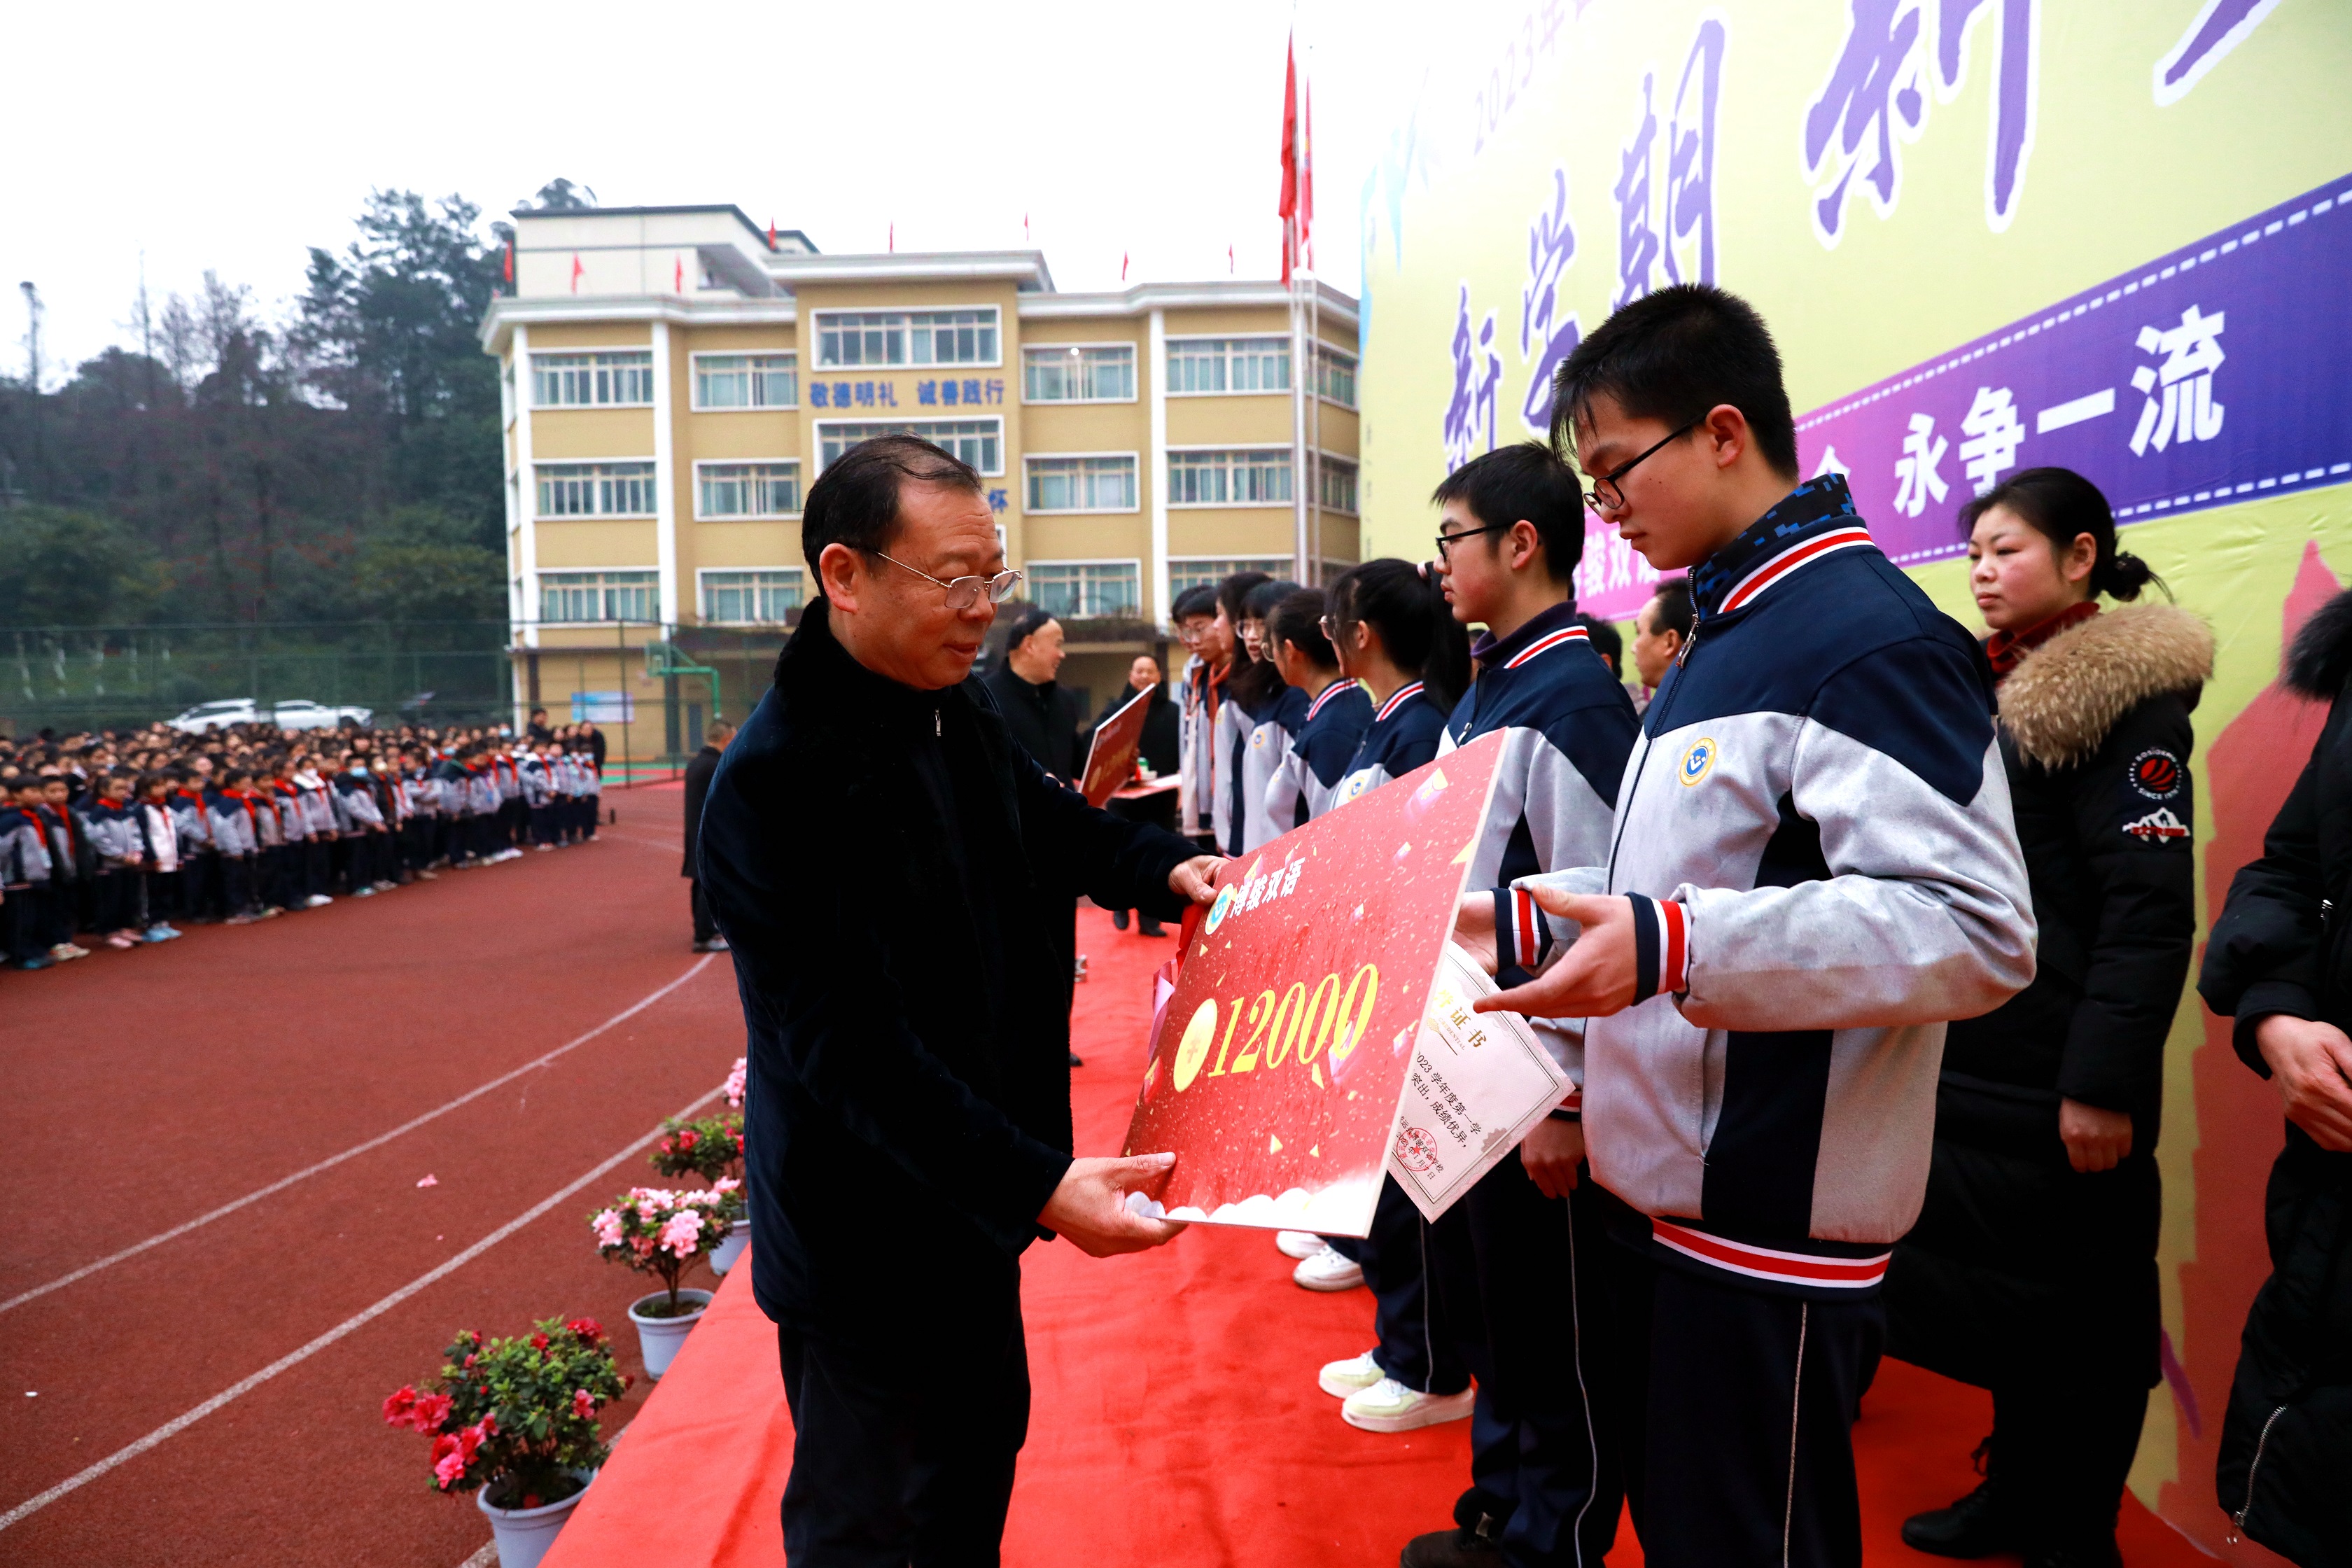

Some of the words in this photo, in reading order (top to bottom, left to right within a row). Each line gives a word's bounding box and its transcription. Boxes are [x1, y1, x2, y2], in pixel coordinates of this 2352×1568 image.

[1474, 0, 1592, 156] 2023年
[1893, 304, 2226, 519] 永争一流
[1229, 857, 1306, 918] 博骏双语
[1208, 963, 1378, 1078] 12000
[1438, 1017, 1466, 1051] CREDENTIAL
[1417, 1050, 1482, 1135] 023学年度第一学
